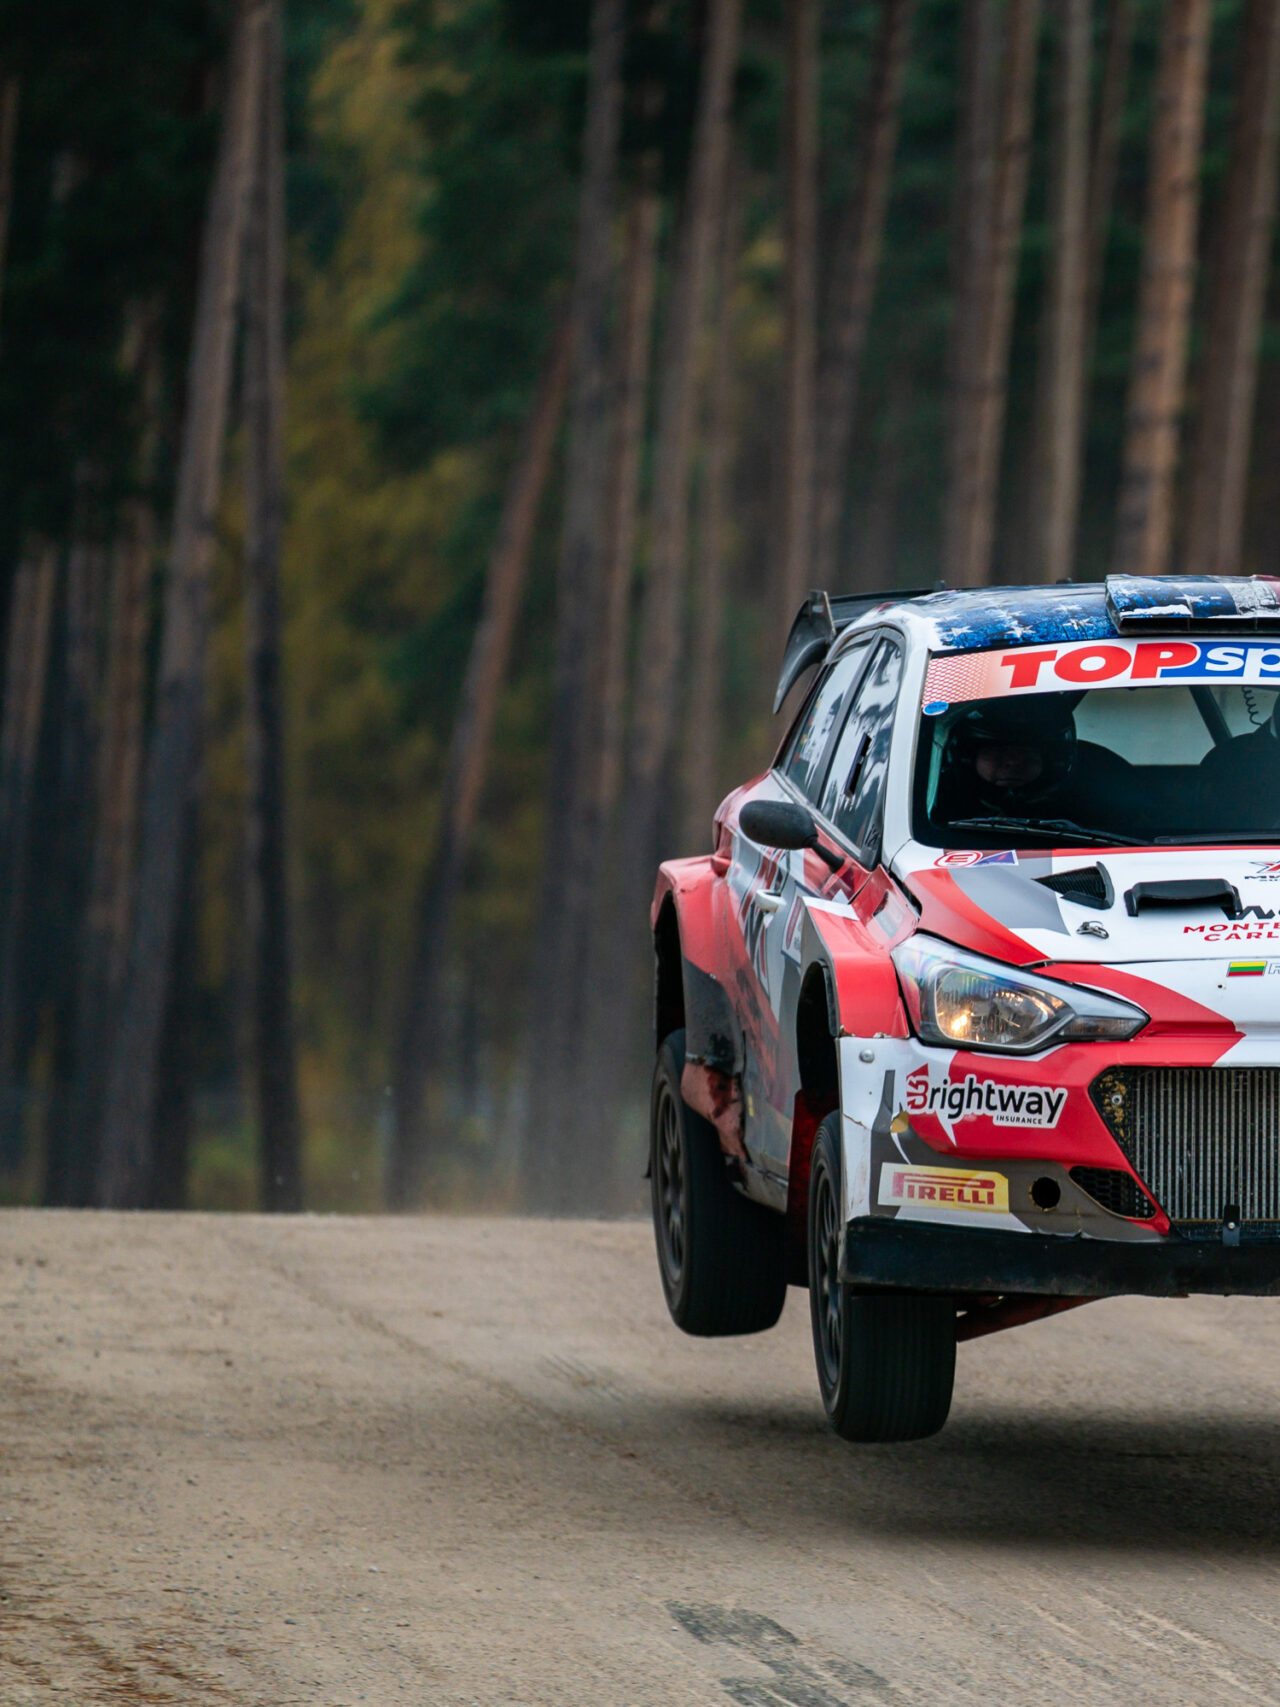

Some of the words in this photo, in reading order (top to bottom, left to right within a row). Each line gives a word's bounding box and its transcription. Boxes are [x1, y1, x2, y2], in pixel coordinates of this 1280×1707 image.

[906, 1077, 1065, 1124] Brightway
[995, 1115, 1043, 1125] INSURANCE
[891, 1171, 996, 1205] PIRELLI
